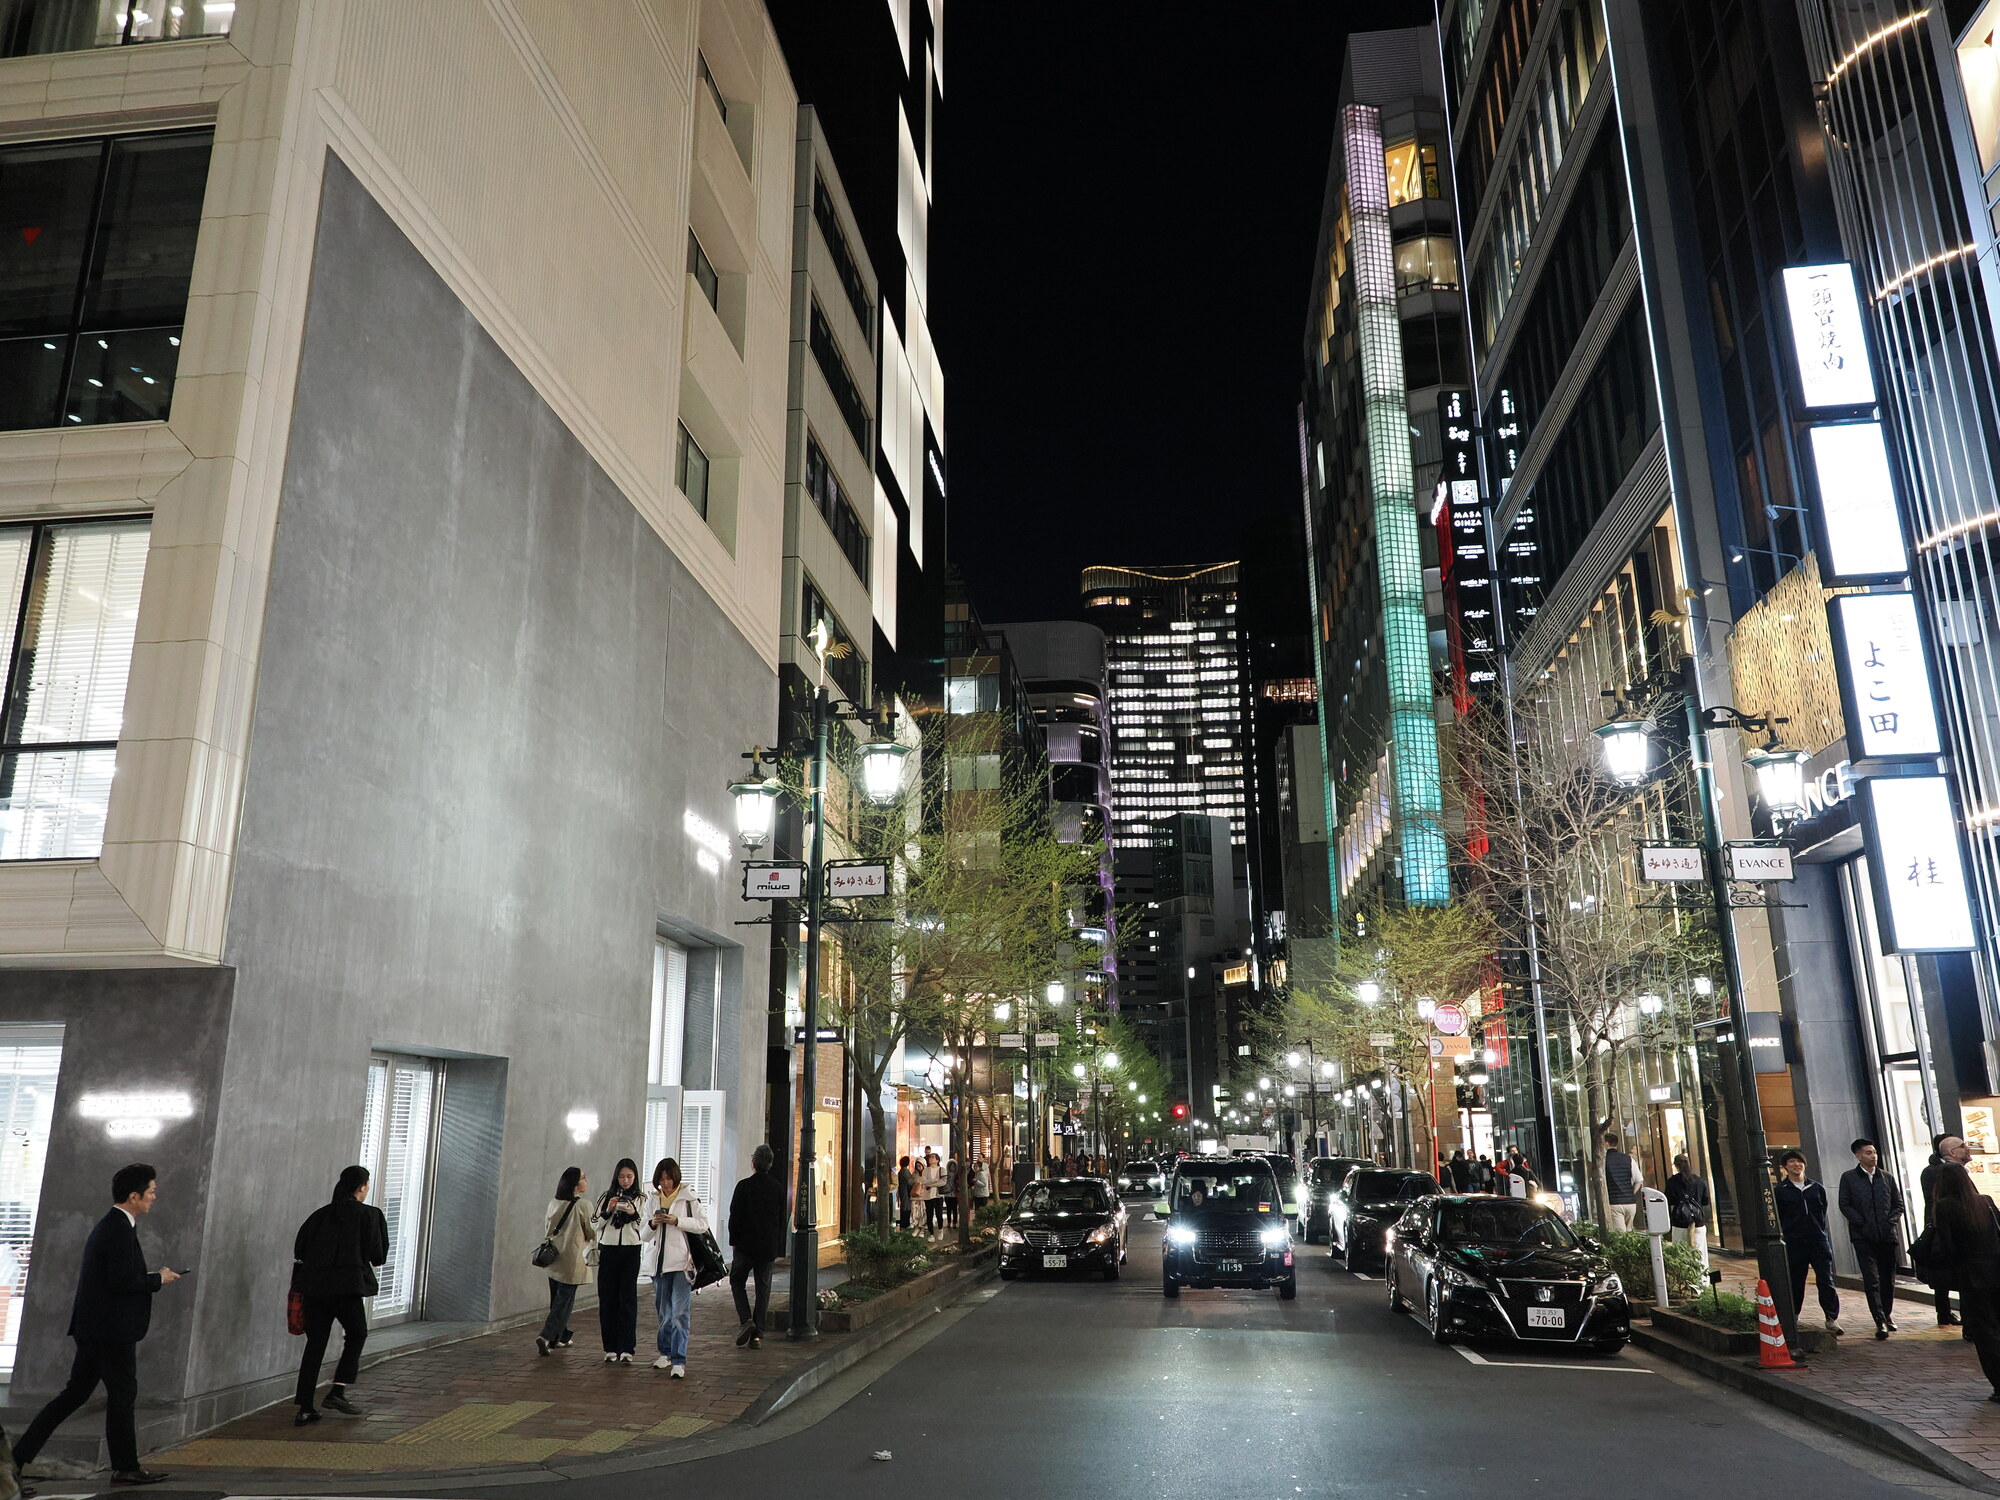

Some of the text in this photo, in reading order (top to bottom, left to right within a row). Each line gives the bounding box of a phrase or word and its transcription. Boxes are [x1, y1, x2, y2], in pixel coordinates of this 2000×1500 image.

[1454, 511, 1481, 519] MASA
[1454, 519, 1483, 527] GINZA
[1864, 640, 1899, 735] よこ田
[1647, 856, 1700, 871] みゆき通り
[1739, 858, 1785, 868] EVANCE
[1907, 856, 1944, 887] 桂
[833, 875, 883, 889] みゆき通り
[1749, 1037, 1780, 1047] VANCE
[1222, 1263, 1243, 1272] 11-99
[1536, 1316, 1563, 1326] 70-00
